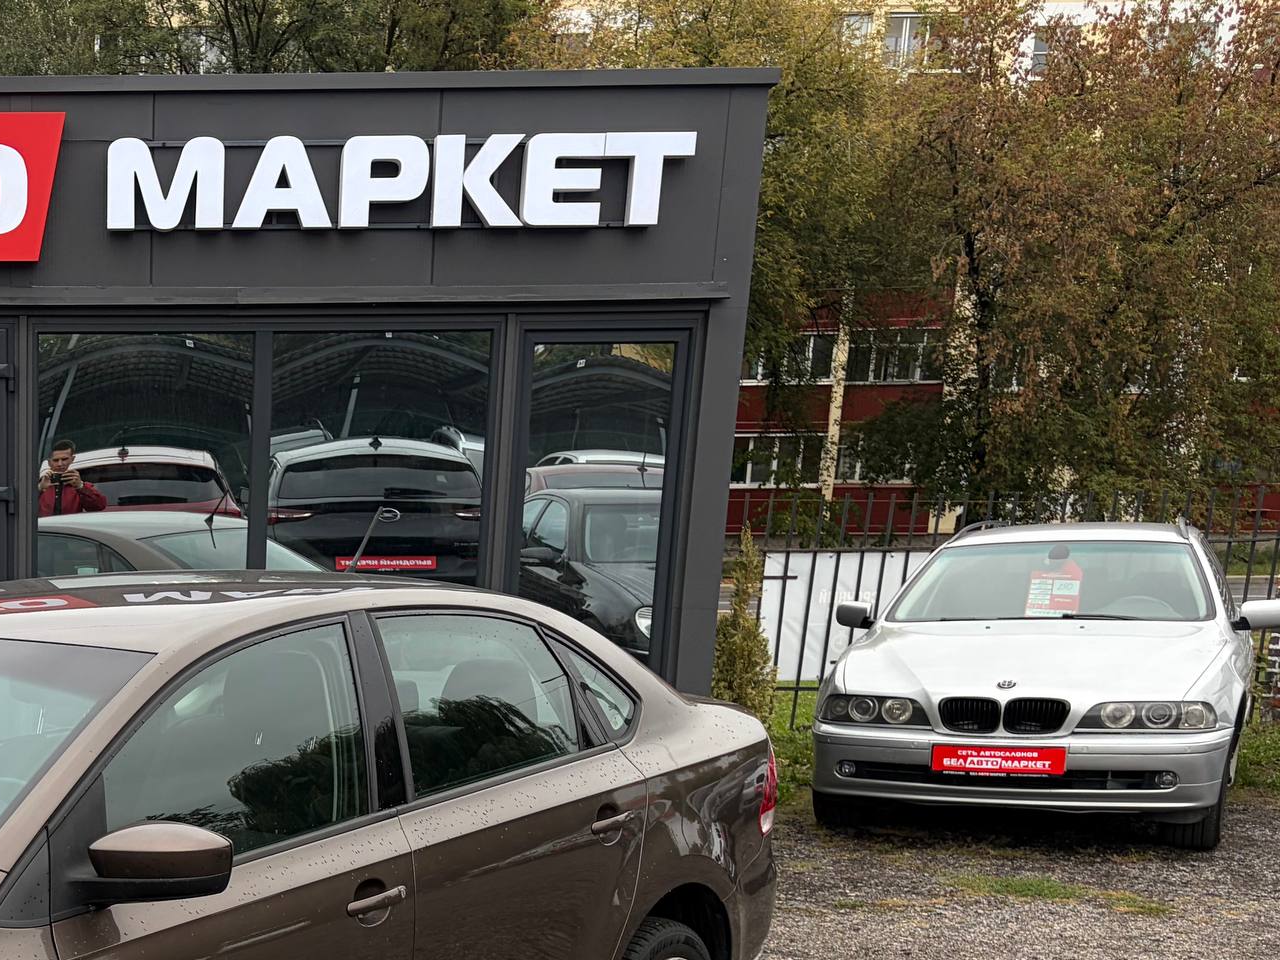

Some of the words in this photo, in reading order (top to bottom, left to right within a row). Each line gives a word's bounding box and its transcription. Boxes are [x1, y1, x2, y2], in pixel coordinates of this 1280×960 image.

[106, 131, 698, 231] МАРКЕТ
[943, 758, 965, 766] БЕЛ
[968, 758, 999, 767] АВТО
[1001, 760, 1052, 768] МАРКЕТ
